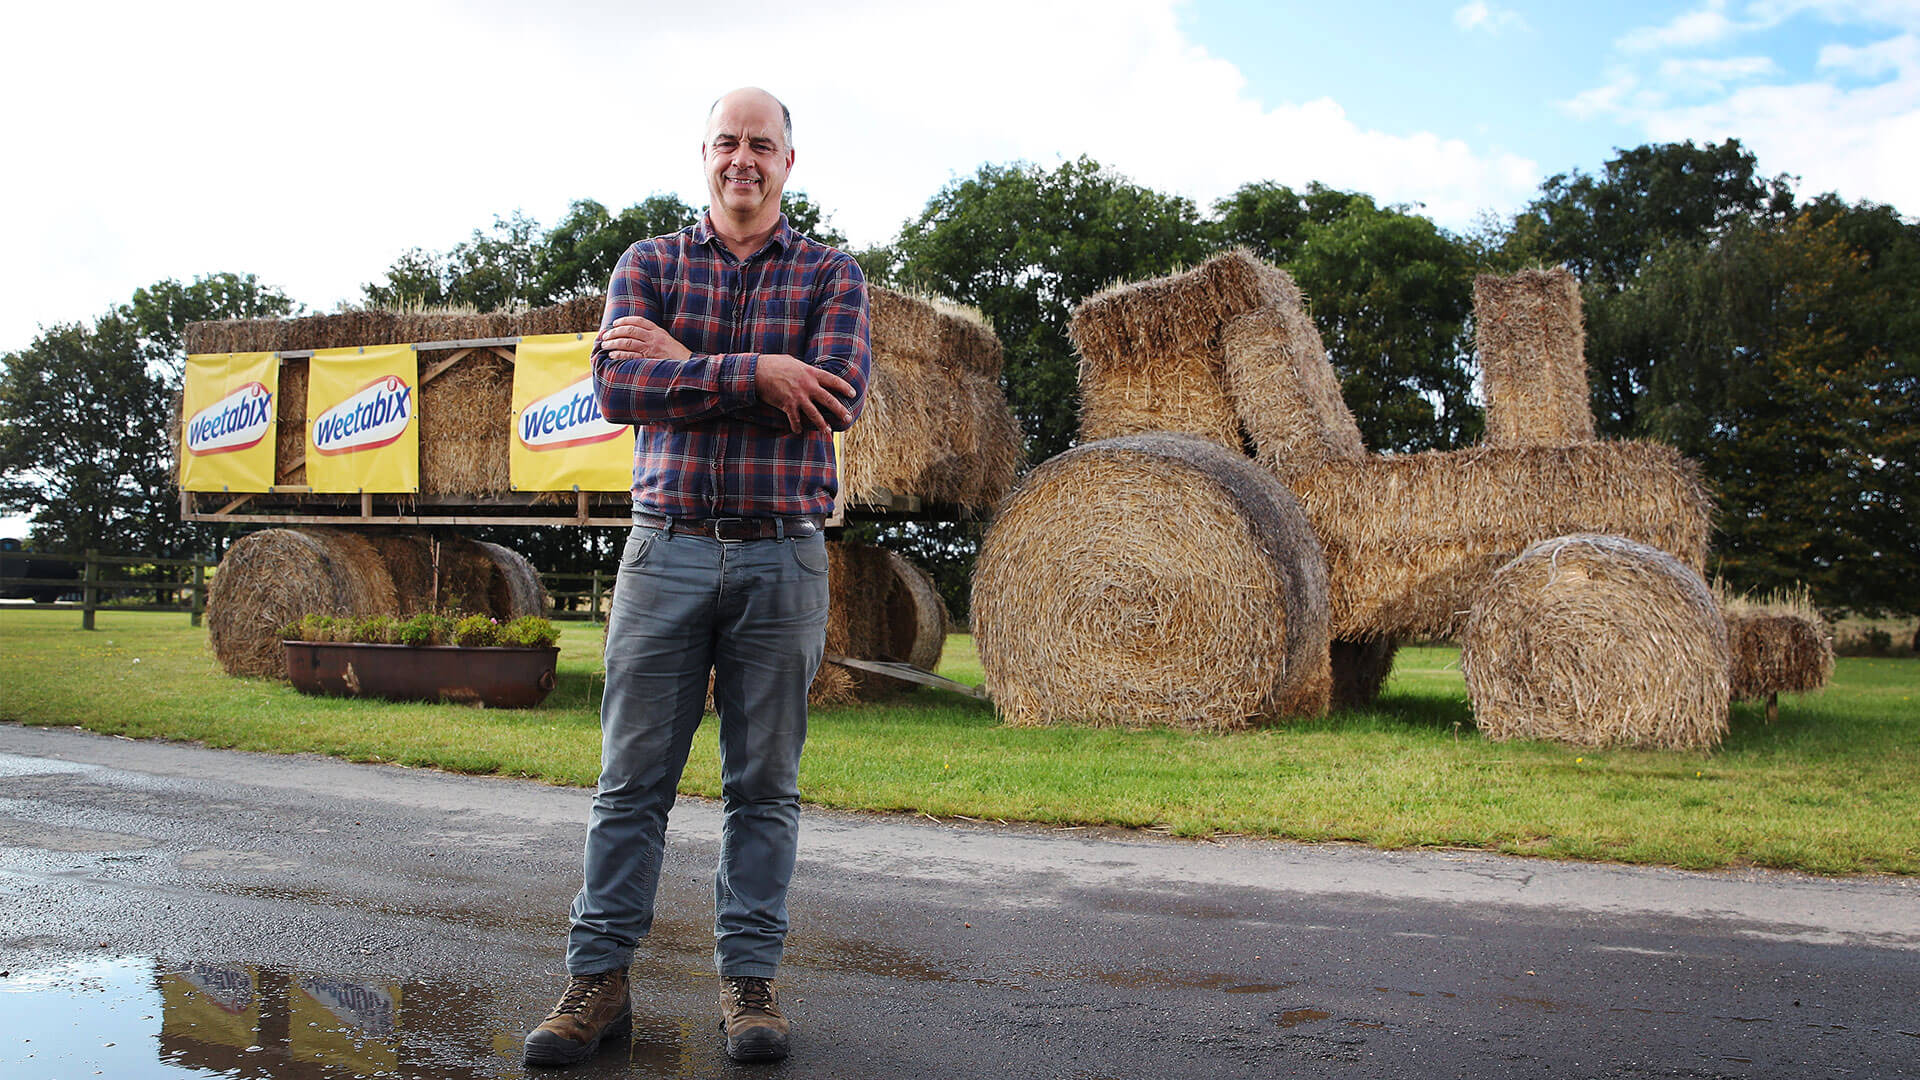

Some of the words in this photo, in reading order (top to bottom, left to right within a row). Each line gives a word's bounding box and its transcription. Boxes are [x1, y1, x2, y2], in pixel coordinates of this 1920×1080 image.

[189, 383, 273, 447] Weetabix
[317, 377, 411, 446] Weetabix
[525, 392, 602, 440] Weeta
